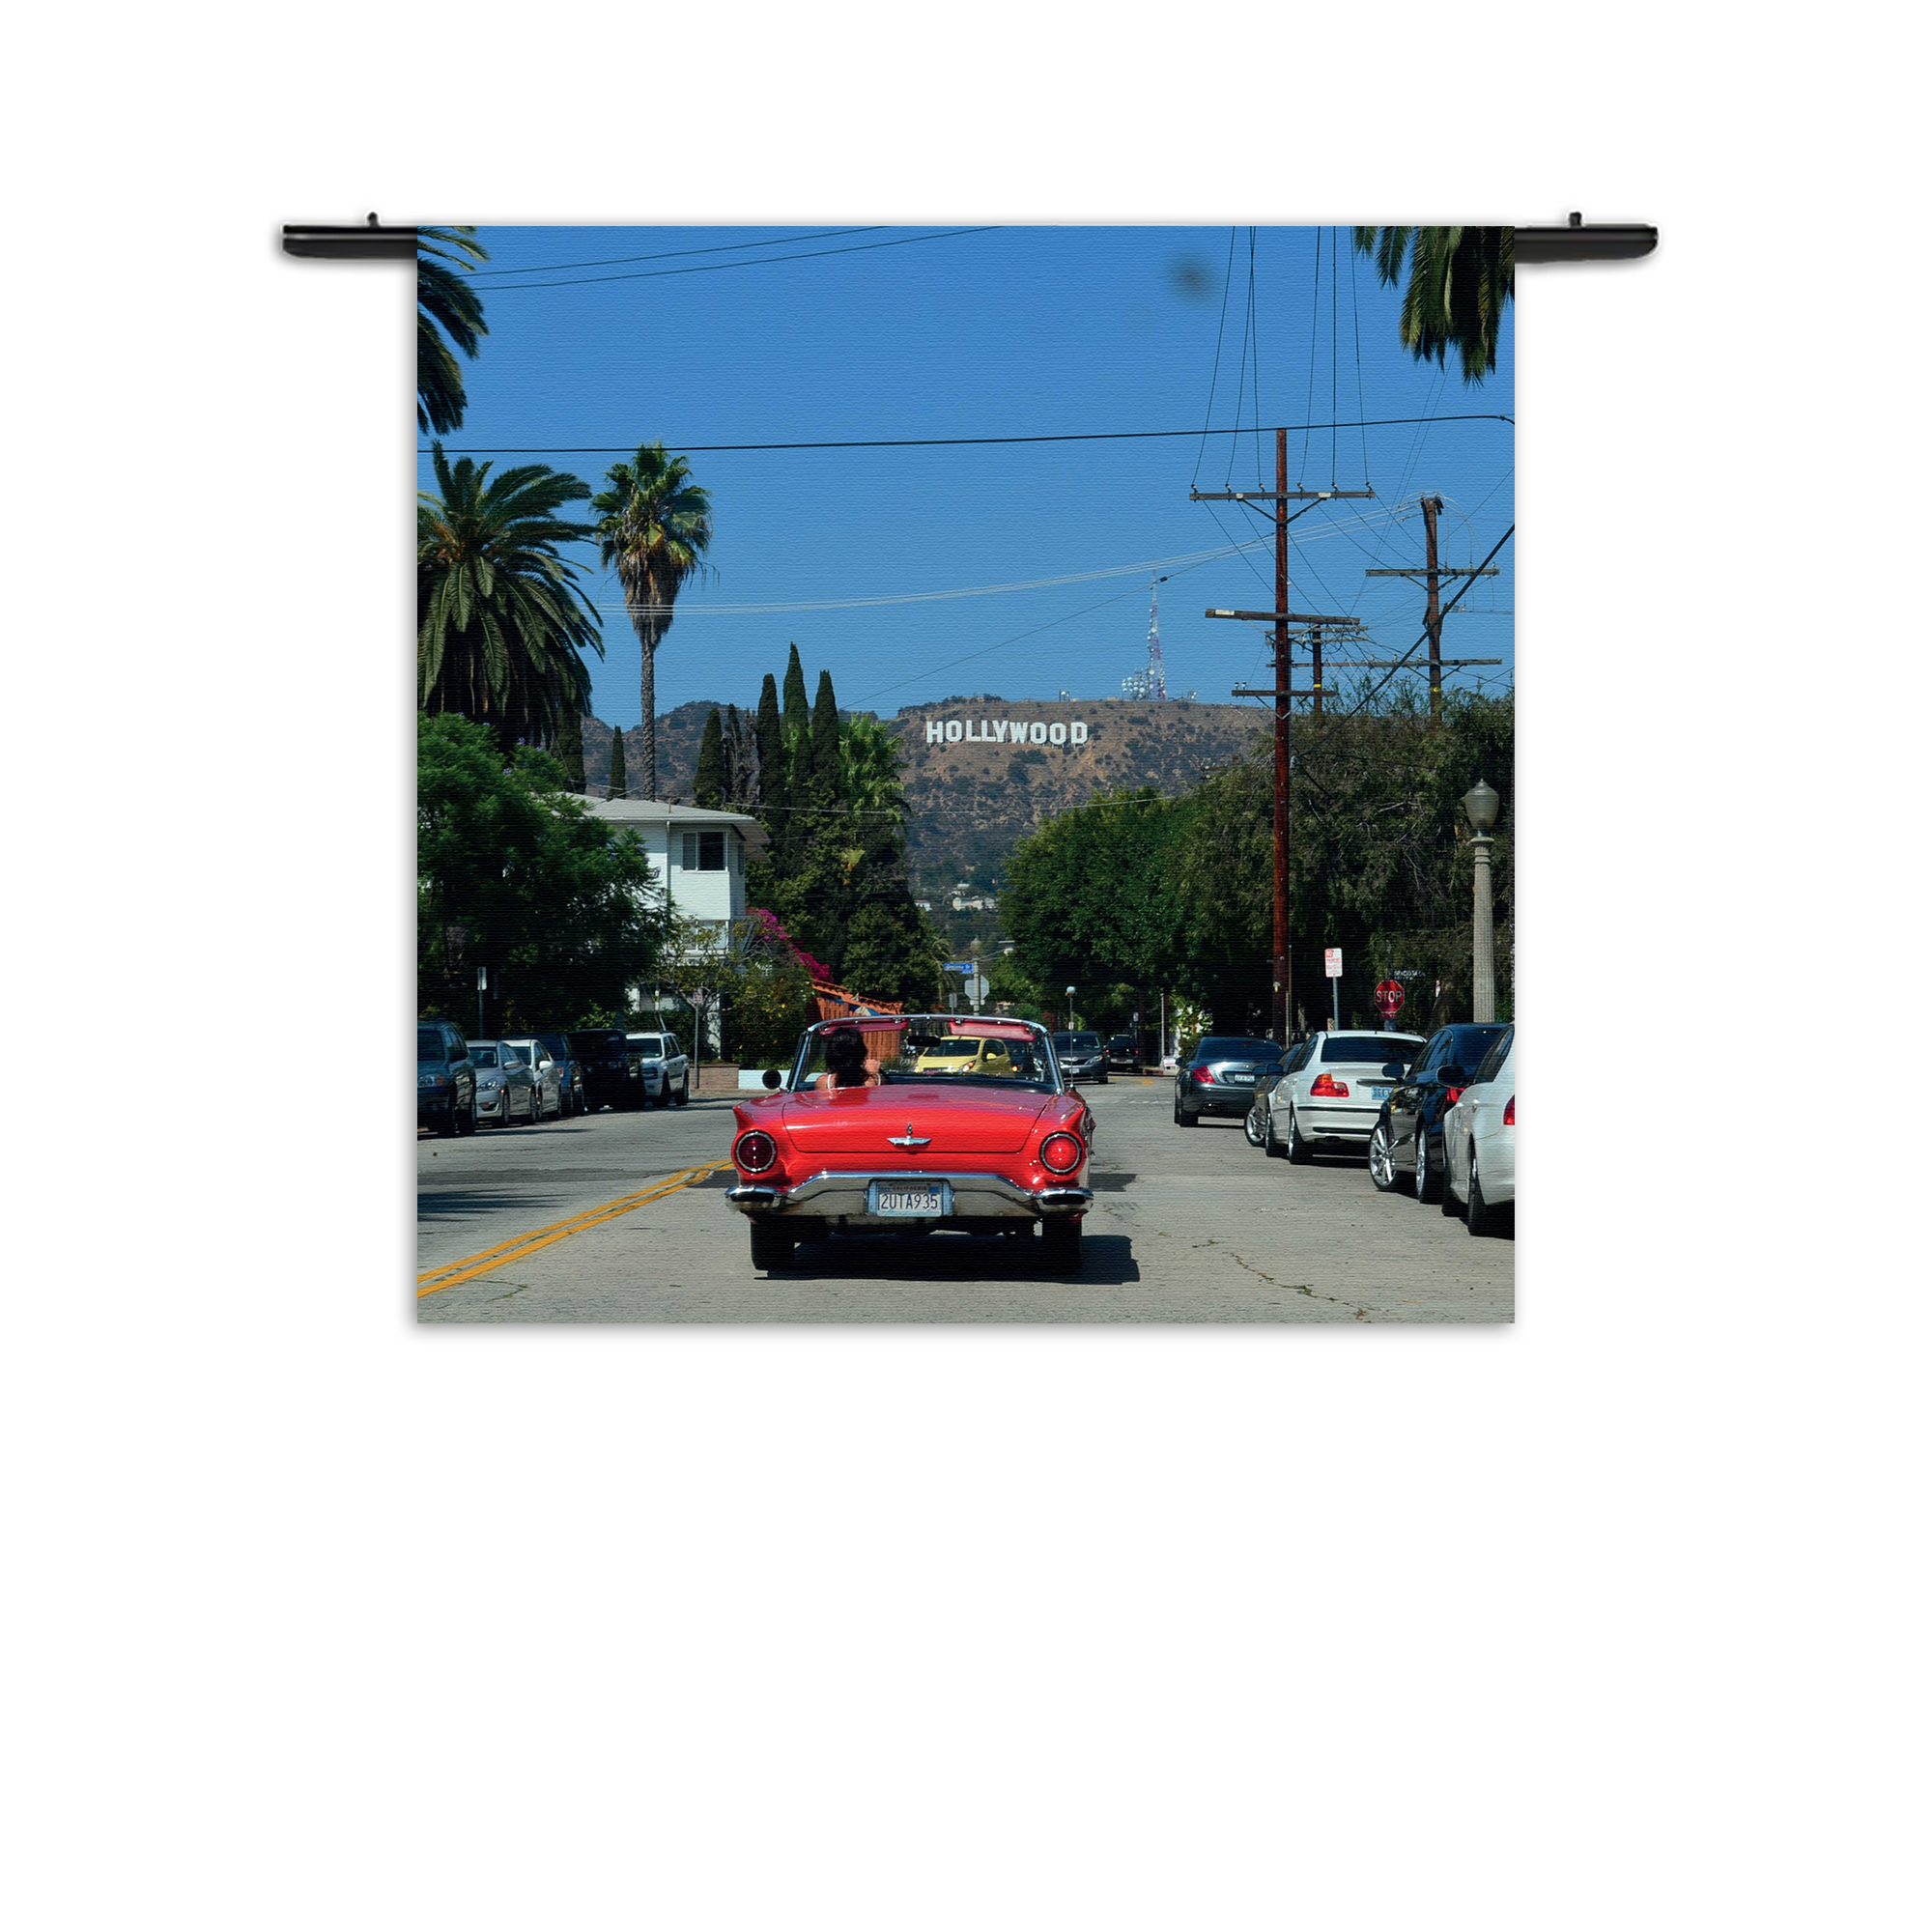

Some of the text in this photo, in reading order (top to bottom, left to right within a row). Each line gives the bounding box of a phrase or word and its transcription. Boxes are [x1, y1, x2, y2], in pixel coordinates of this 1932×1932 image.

[926, 720, 1088, 745] HOLLYWOOD
[1376, 990, 1403, 1003] STOP
[881, 1193, 938, 1209] 2UTA935
